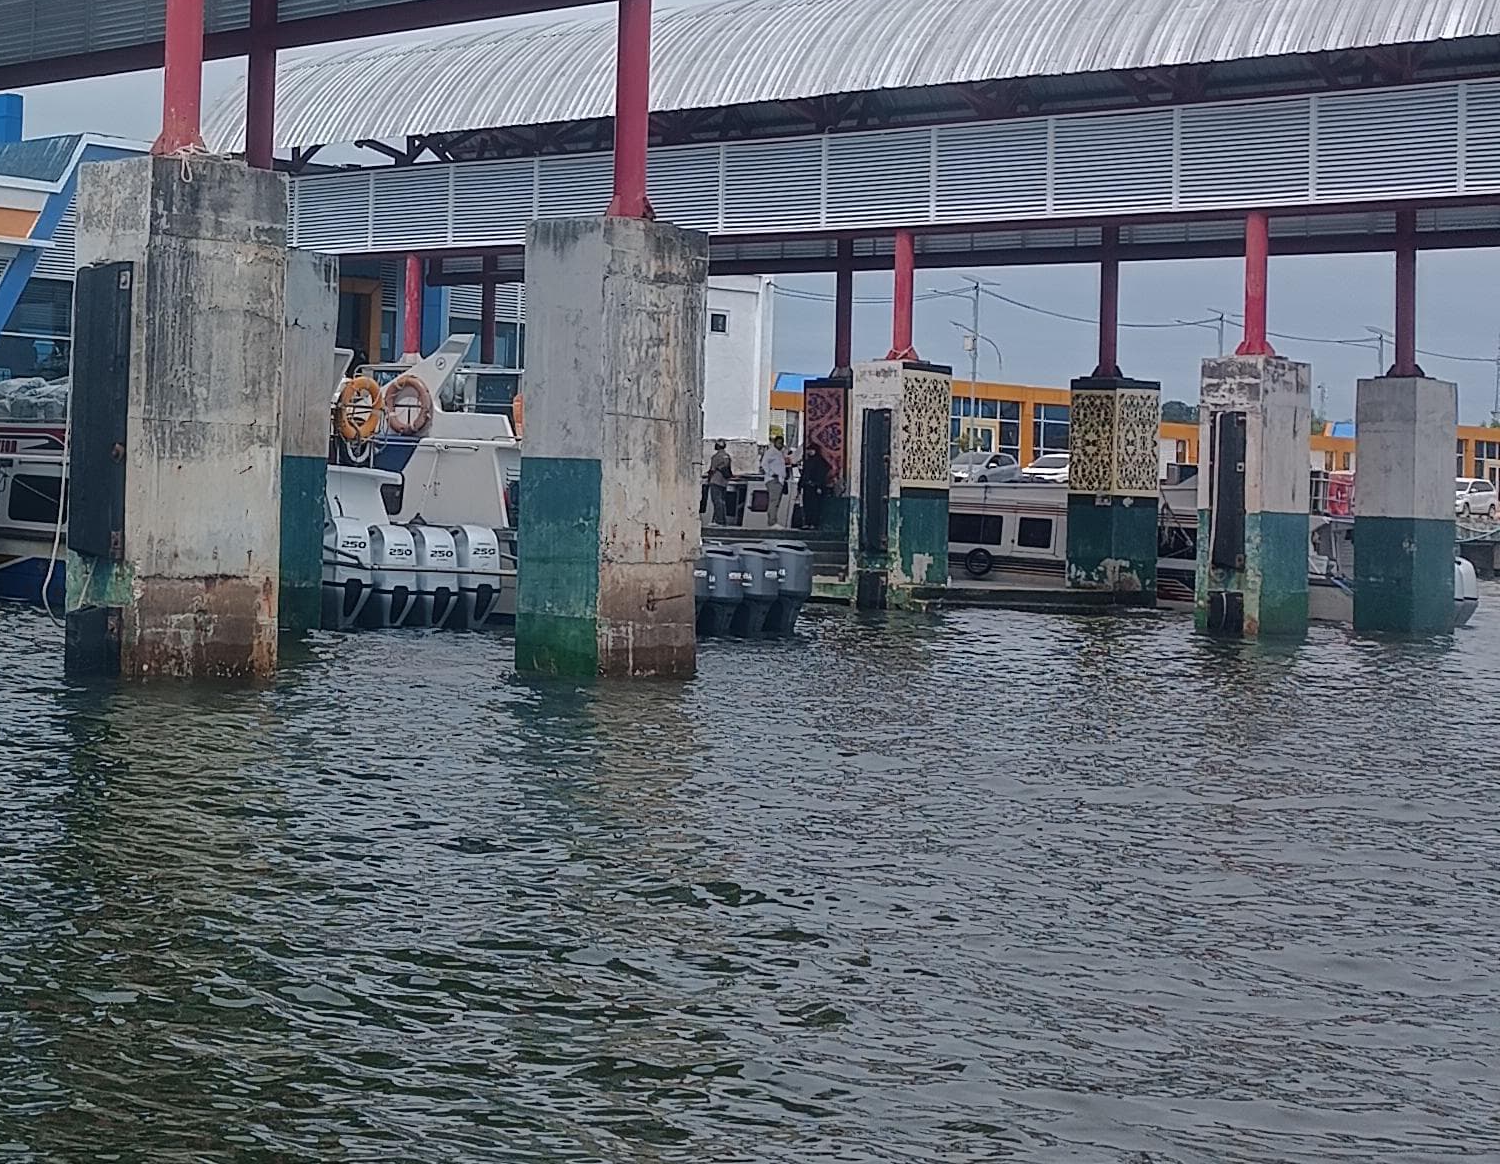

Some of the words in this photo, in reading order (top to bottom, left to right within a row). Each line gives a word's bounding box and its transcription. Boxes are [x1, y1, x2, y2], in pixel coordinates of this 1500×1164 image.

[341, 540, 367, 549] 250
[388, 548, 413, 556] 250
[430, 550, 454, 558] 250
[472, 547, 497, 556] 250
